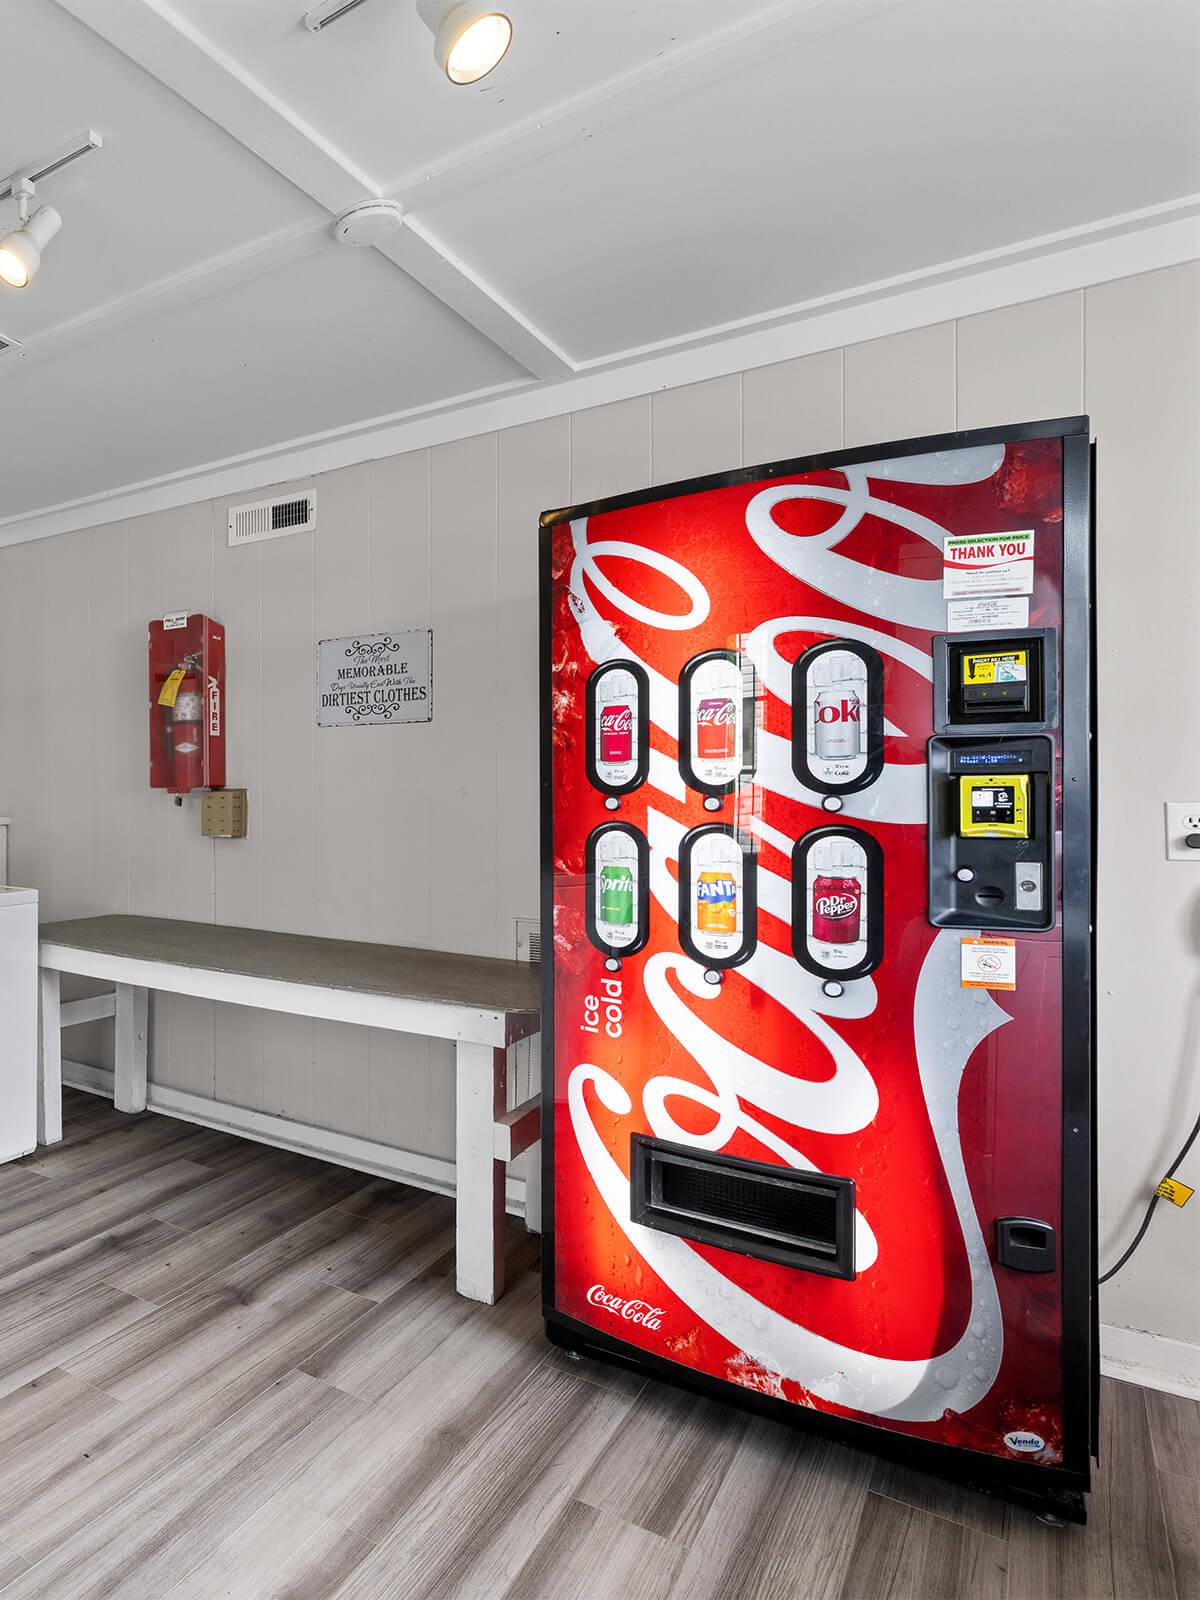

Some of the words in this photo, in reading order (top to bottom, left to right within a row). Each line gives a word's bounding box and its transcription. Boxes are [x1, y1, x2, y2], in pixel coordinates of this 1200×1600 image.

[950, 545, 994, 560] THANK
[1000, 542, 1026, 556] YOU
[369, 654, 390, 665] Most
[338, 662, 408, 680] MEMORABLE
[330, 683, 346, 692] Days
[347, 682, 370, 690] Usually
[385, 678, 402, 687] With
[403, 676, 416, 684] The
[322, 691, 371, 707] DIRTIEST
[374, 686, 427, 704] CLOTHES
[211, 691, 220, 732] FIRE
[817, 897, 855, 916] Pepper
[830, 896, 846, 905] Dr
[580, 994, 599, 1033] ice
[601, 978, 623, 1038] cold
[586, 1284, 666, 1330] Coca-Cola
[1008, 1436, 1040, 1445] Vendo
